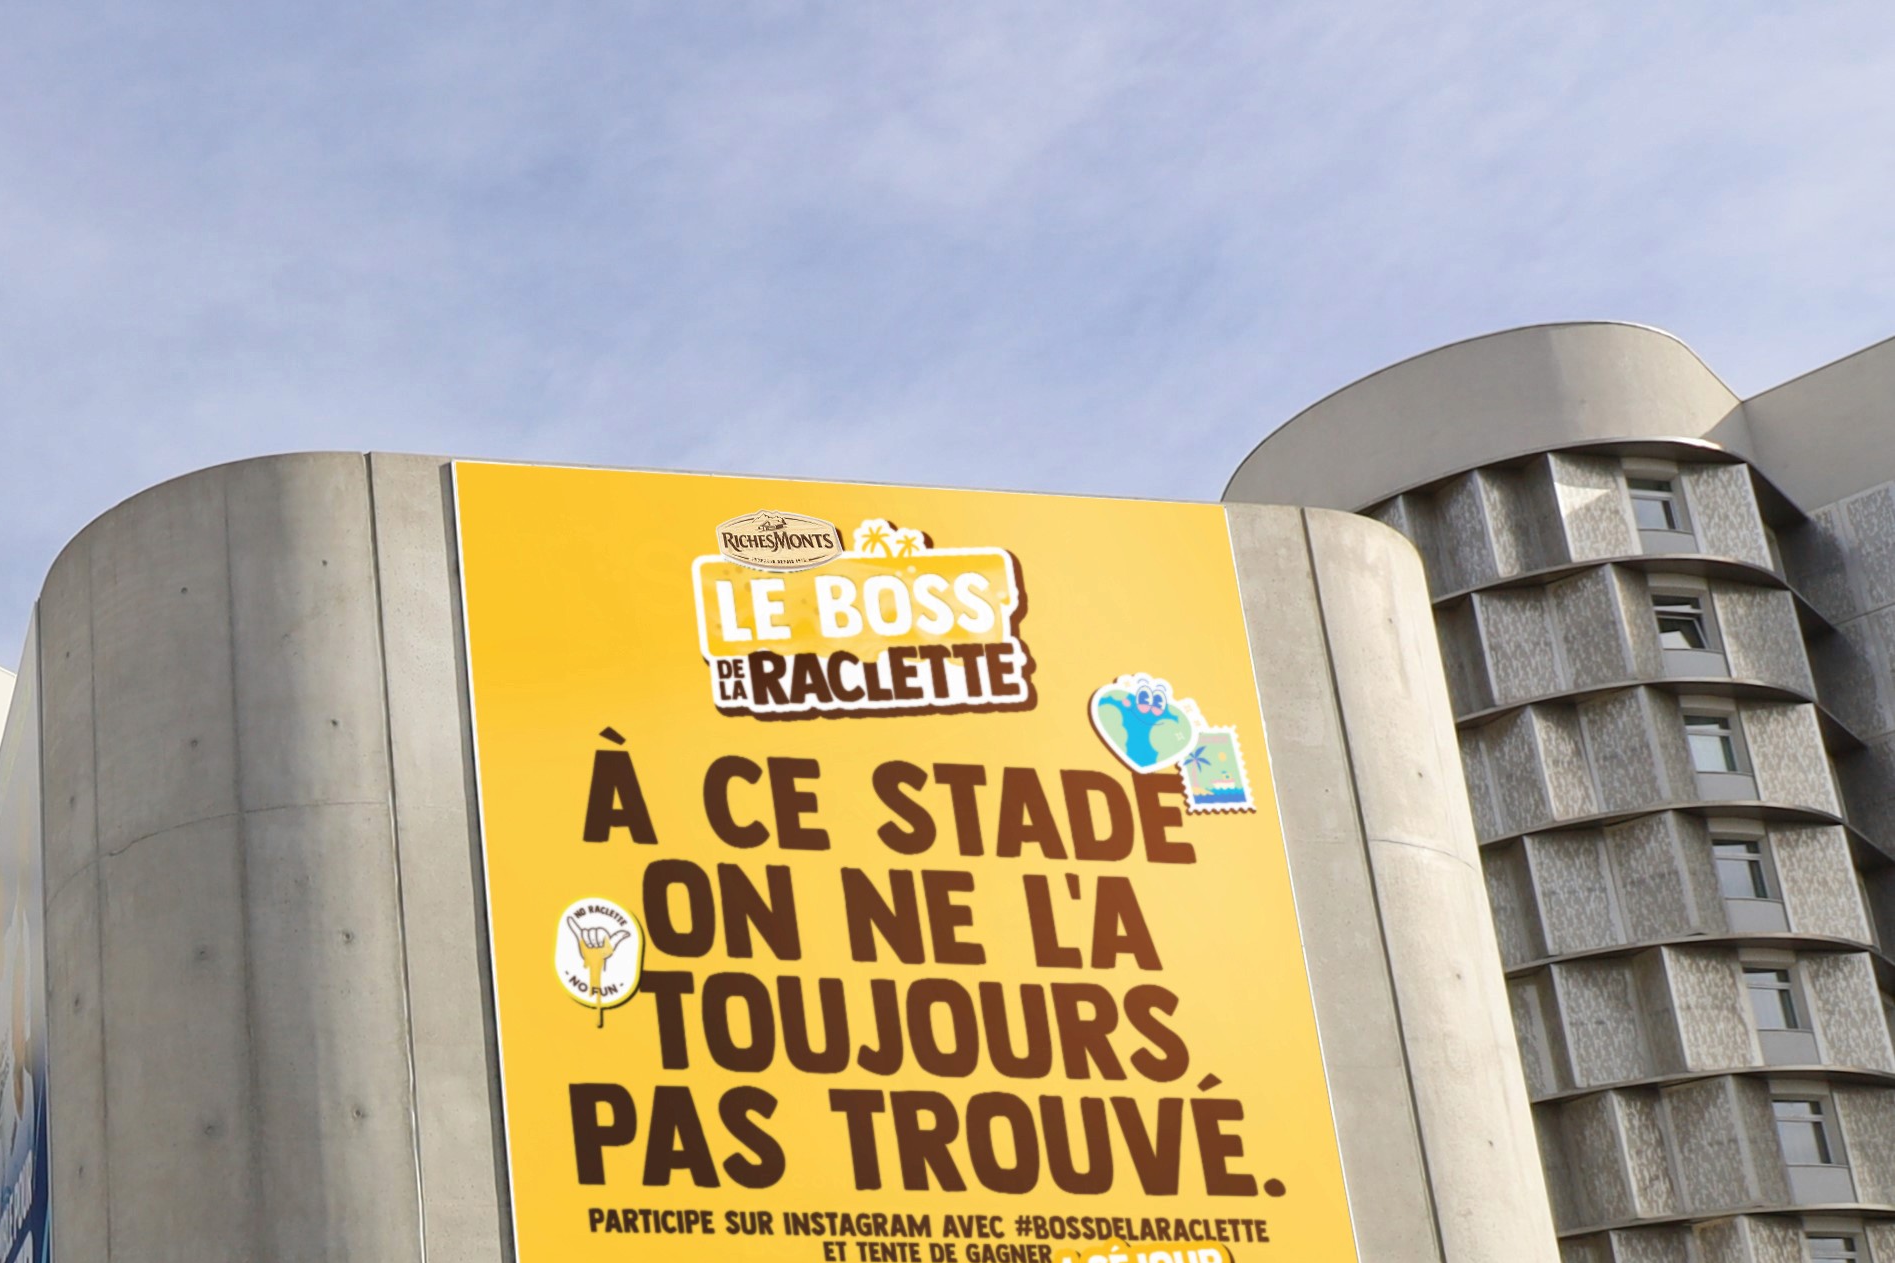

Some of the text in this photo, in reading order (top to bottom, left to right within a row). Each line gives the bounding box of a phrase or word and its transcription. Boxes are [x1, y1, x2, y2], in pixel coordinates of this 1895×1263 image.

[715, 572, 996, 642] LE BOSS
[717, 643, 1021, 705] DE RACLETTE
[719, 680, 748, 701] LA
[582, 726, 1198, 865] À CE STADE
[574, 905, 628, 926] NO RACLETTE
[642, 858, 1164, 971] ON NE L'A
[569, 975, 588, 993] NO
[639, 971, 1191, 1083] TOUJOURS
[569, 1072, 1287, 1199] PAS TROUVÉ.
[588, 1208, 1270, 1243] PARTICIPE SUR INSTAGRAM AVEC #BOSSDELARACLETTE
[823, 1241, 847, 1262] ET
[856, 1241, 922, 1263] TENTE
[929, 1243, 958, 1263] DE
